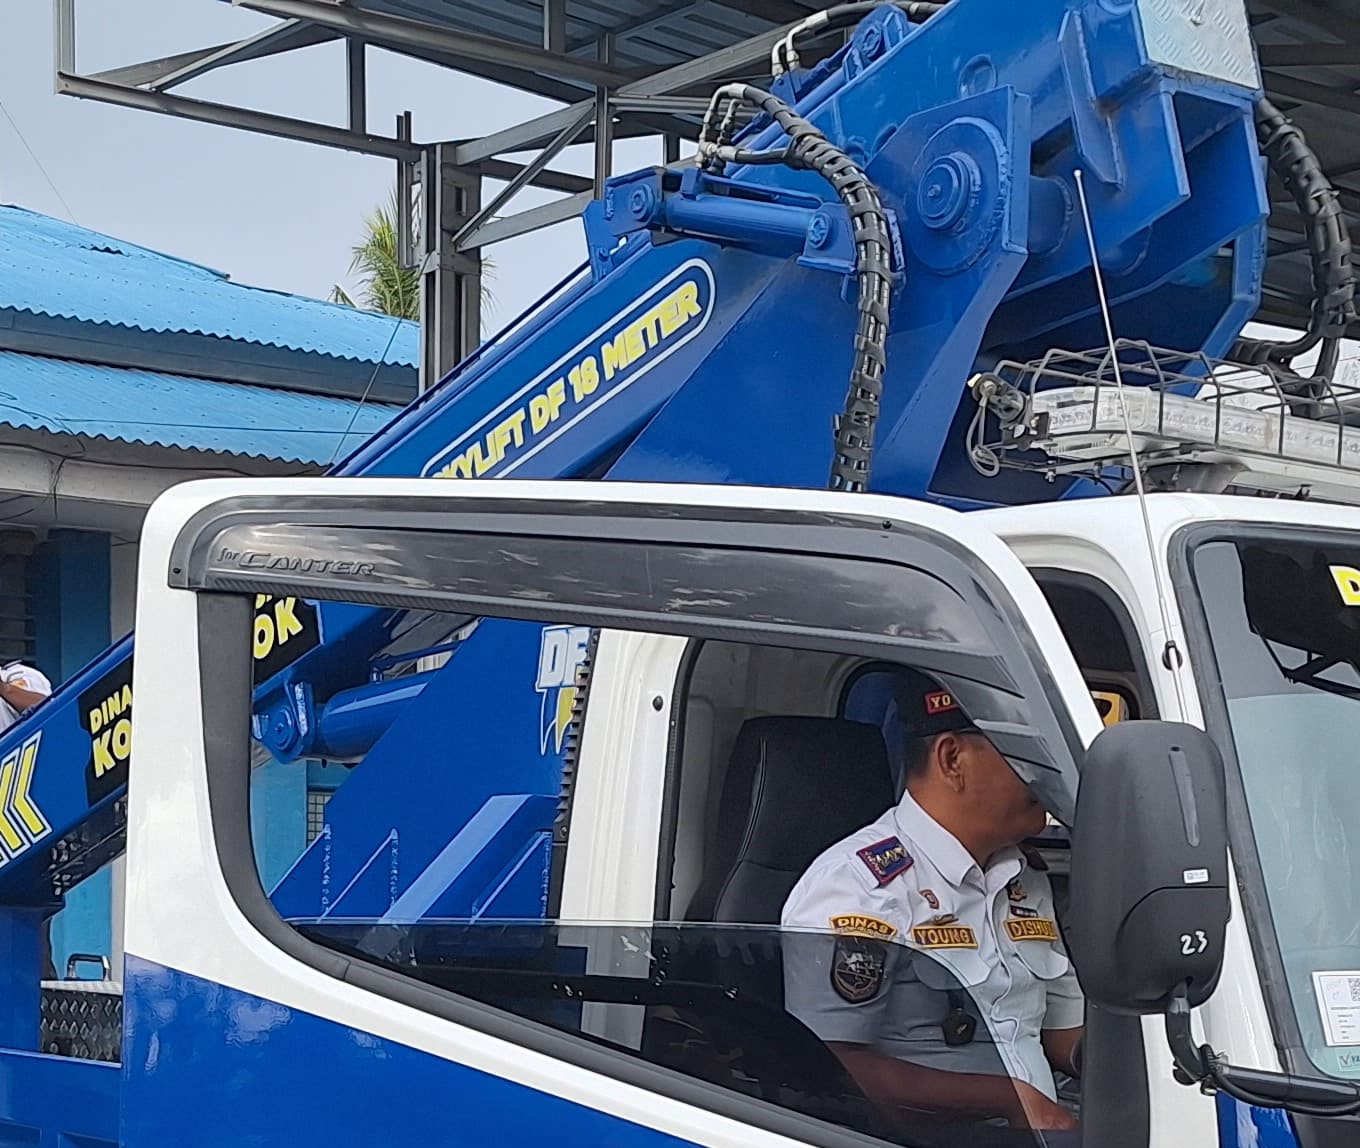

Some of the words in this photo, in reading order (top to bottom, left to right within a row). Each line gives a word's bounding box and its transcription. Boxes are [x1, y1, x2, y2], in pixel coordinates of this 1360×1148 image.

[432, 408, 526, 478] KYLIFT
[529, 377, 565, 435] DF
[568, 356, 599, 403] 18
[601, 280, 702, 381] METER
[239, 551, 375, 576] CANTER
[838, 918, 888, 933] DINAS
[916, 928, 970, 945] YOUNG
[1180, 930, 1208, 955] 23
